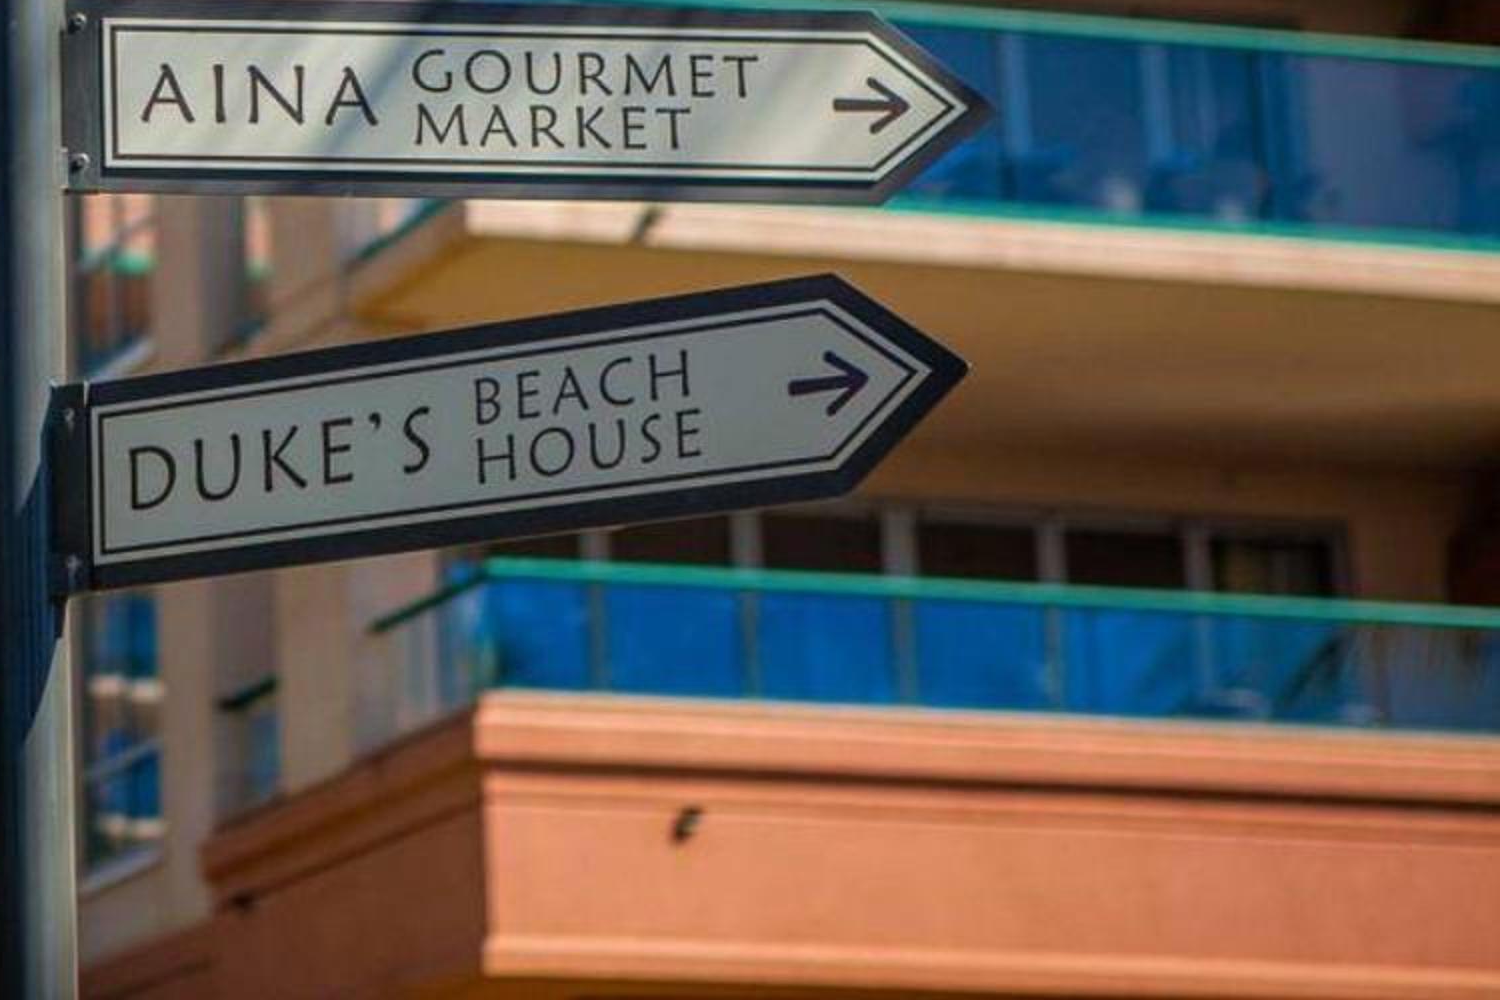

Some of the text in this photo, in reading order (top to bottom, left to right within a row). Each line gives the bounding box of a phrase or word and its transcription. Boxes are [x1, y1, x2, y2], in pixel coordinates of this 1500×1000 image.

[140, 62, 380, 126] AINA
[412, 48, 759, 99] GOURMET
[413, 104, 691, 150] MARKET
[473, 350, 691, 426] BEACH
[128, 405, 433, 511] DUKE'S
[476, 408, 703, 484] HOUSE
